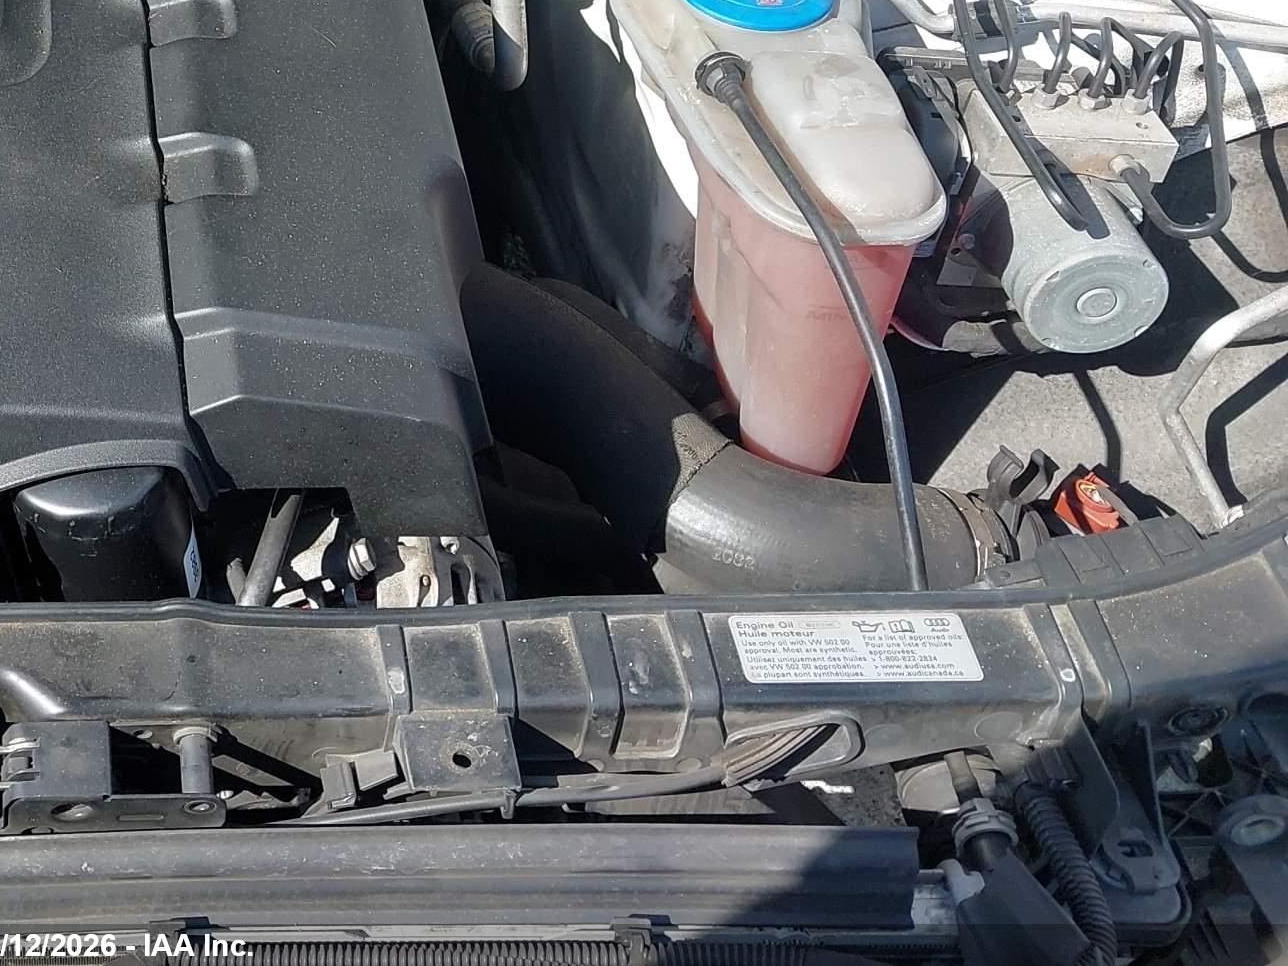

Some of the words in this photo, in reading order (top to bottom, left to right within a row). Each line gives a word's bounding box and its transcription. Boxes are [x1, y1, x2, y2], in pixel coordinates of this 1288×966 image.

[735, 621, 775, 630] Engine
[778, 621, 794, 629] Oil
[737, 630, 768, 638] Huile
[771, 630, 815, 638] moteur
[909, 634, 946, 642] approved
[758, 639, 776, 648] only
[777, 656, 825, 664] uniquement
[763, 671, 791, 679] plupart
